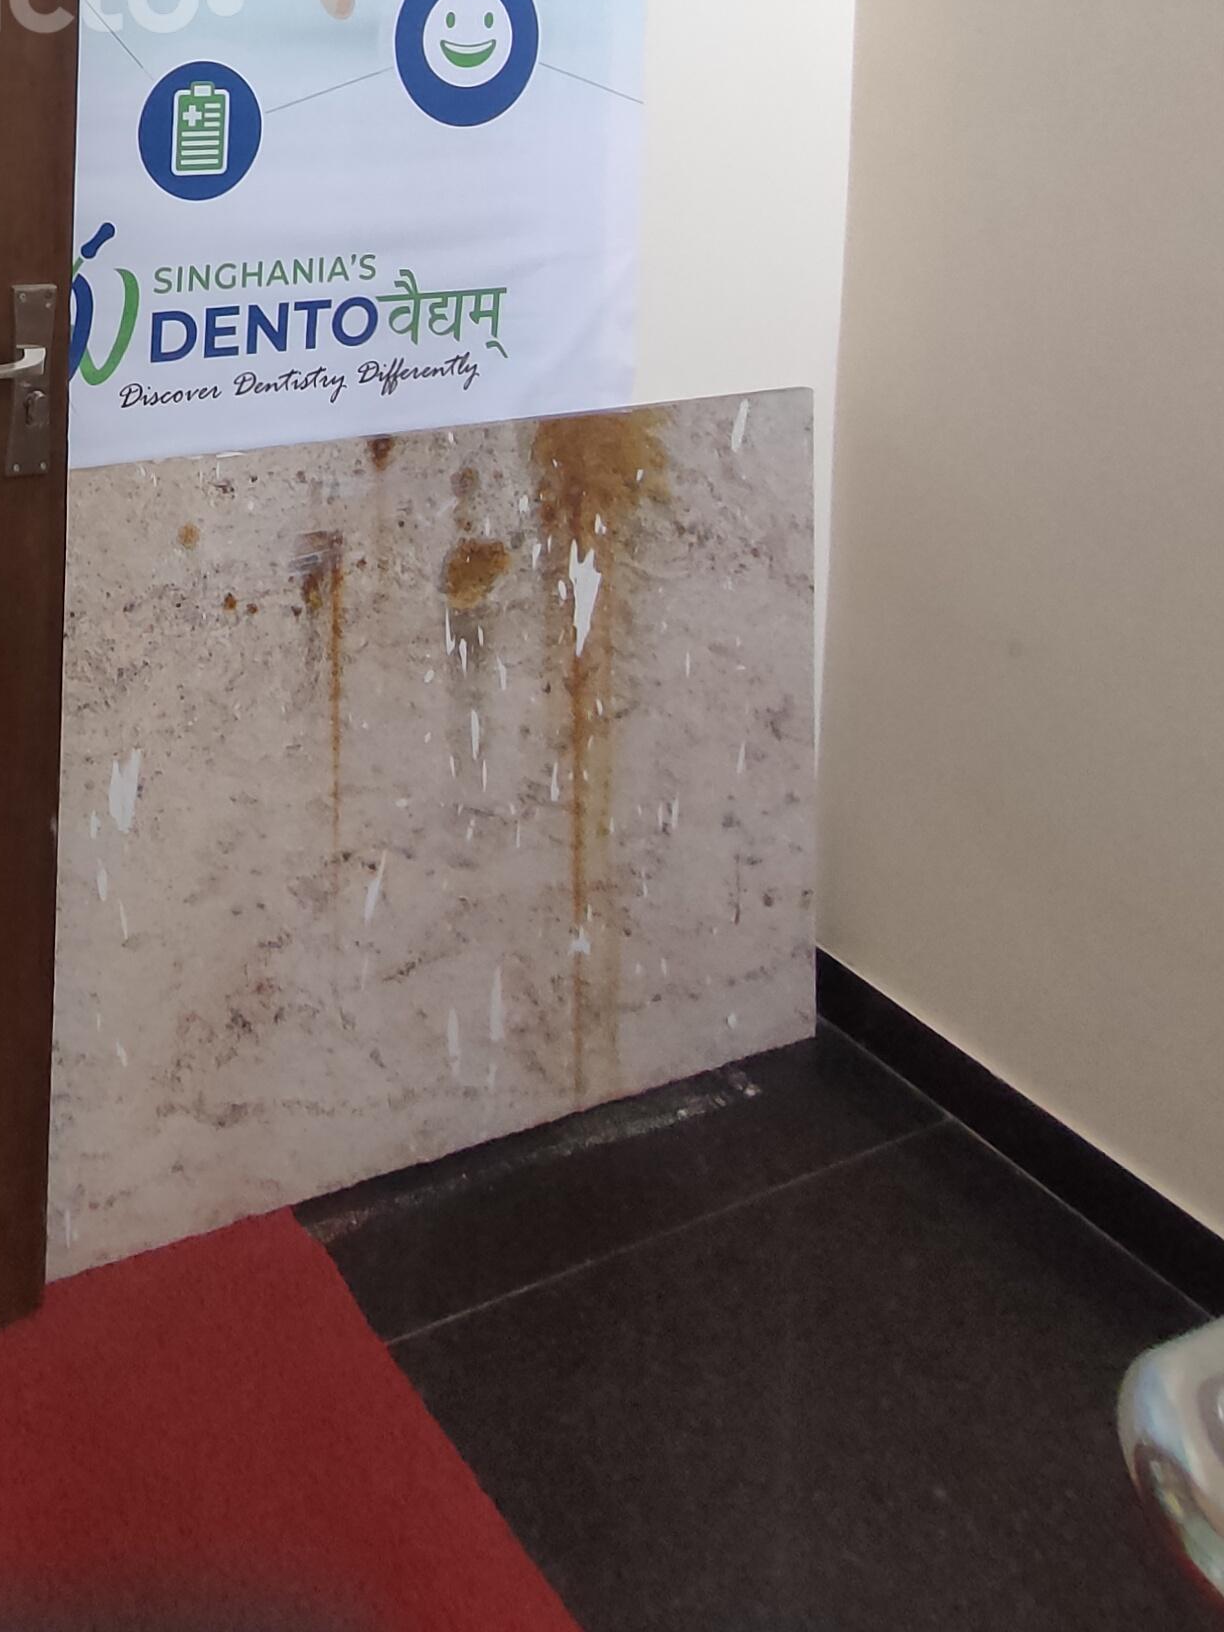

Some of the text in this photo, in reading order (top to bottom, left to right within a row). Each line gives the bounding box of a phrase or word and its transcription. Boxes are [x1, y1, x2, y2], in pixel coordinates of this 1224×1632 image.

[153, 254, 377, 295] SINGHANIA'S
[120, 352, 480, 408] Discover Dentistry Differently
